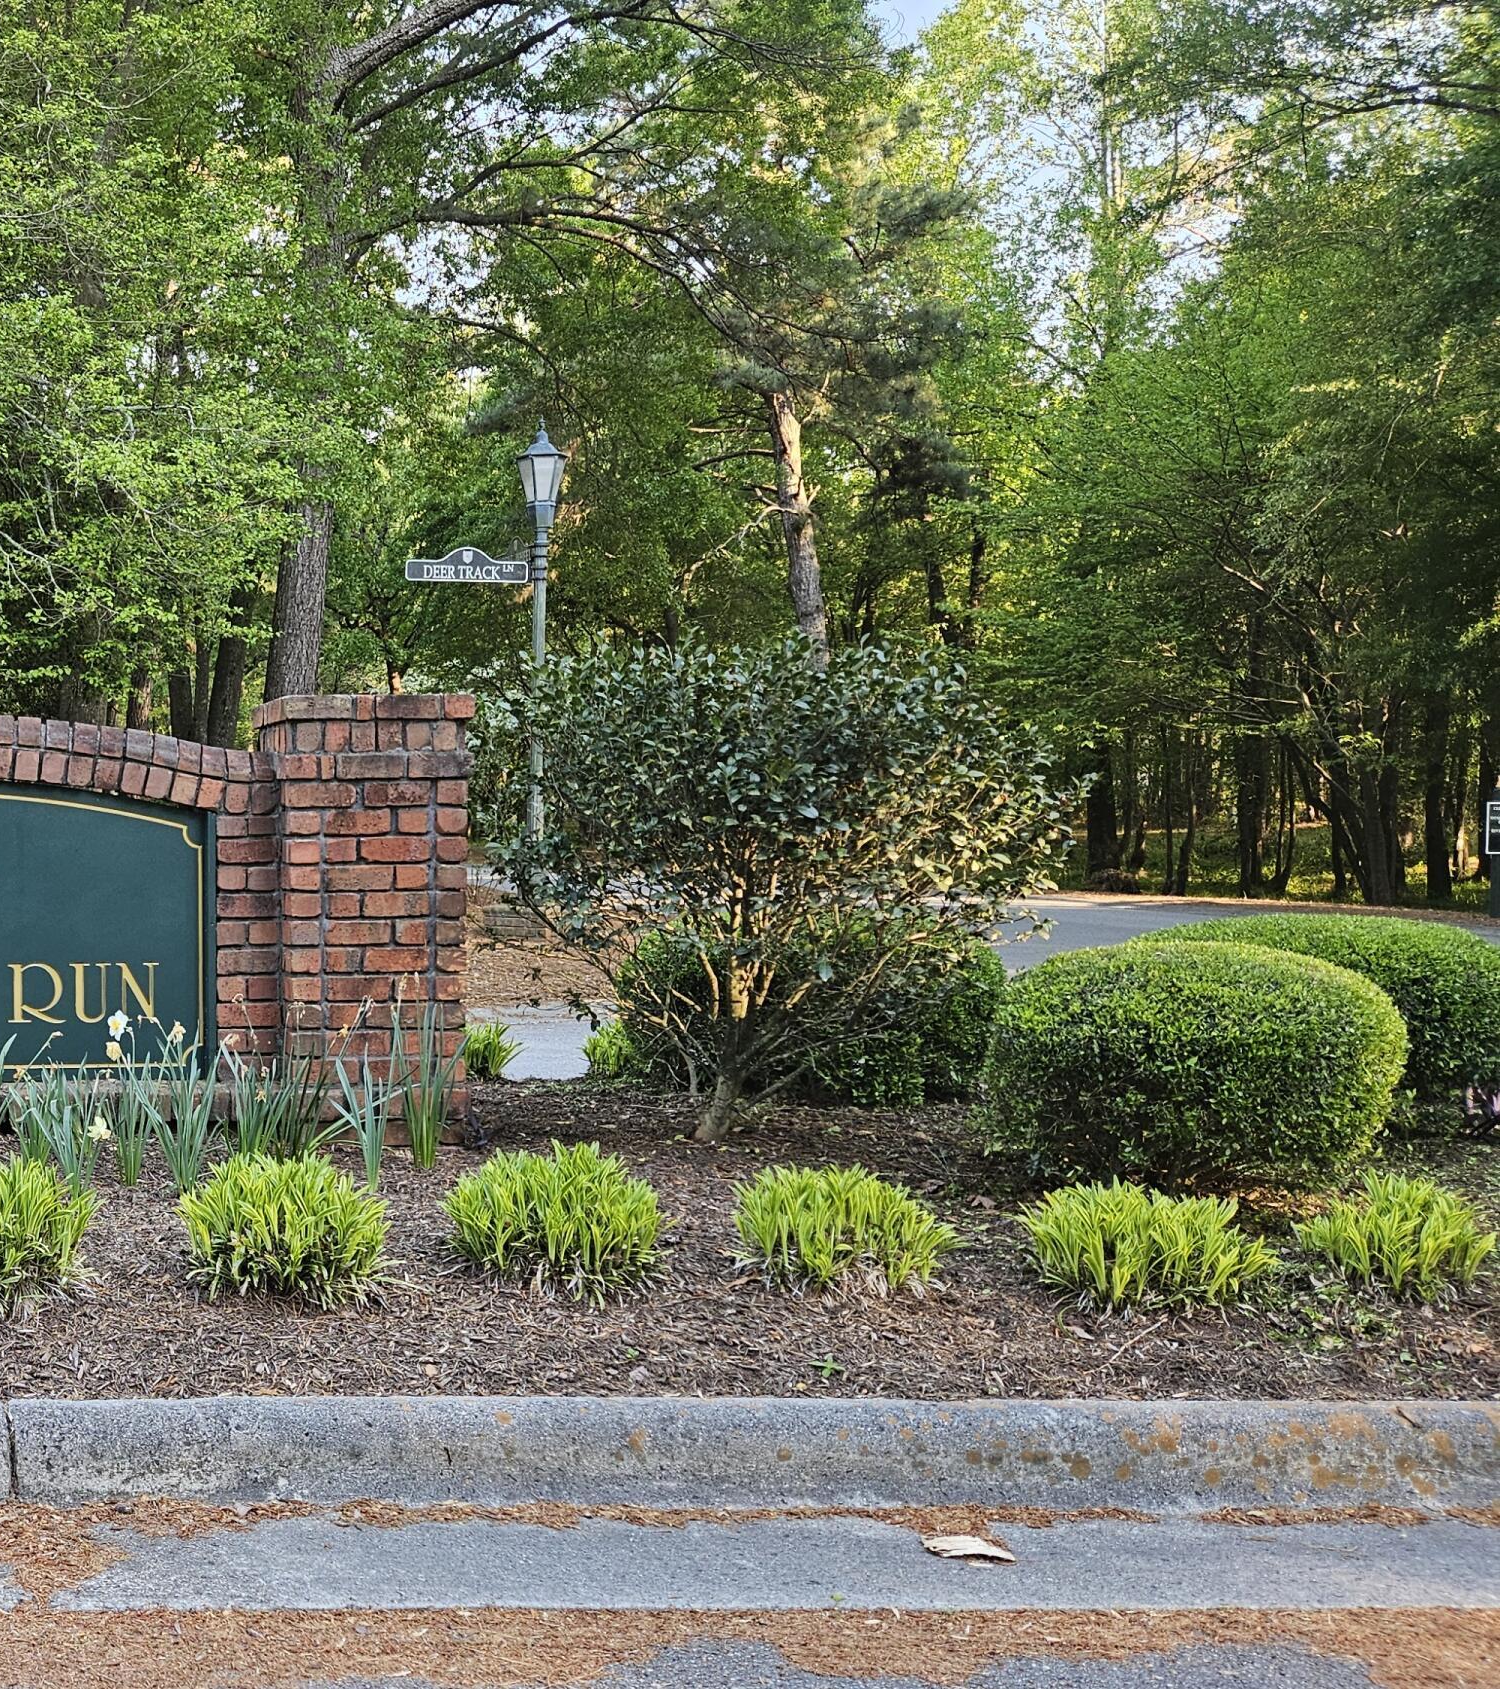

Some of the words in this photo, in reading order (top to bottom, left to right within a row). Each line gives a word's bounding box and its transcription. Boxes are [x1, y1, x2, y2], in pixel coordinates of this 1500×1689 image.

[423, 564, 455, 579] DEER
[458, 565, 500, 580] TRACK
[502, 564, 514, 572] LN
[8, 961, 160, 1025] RUN
